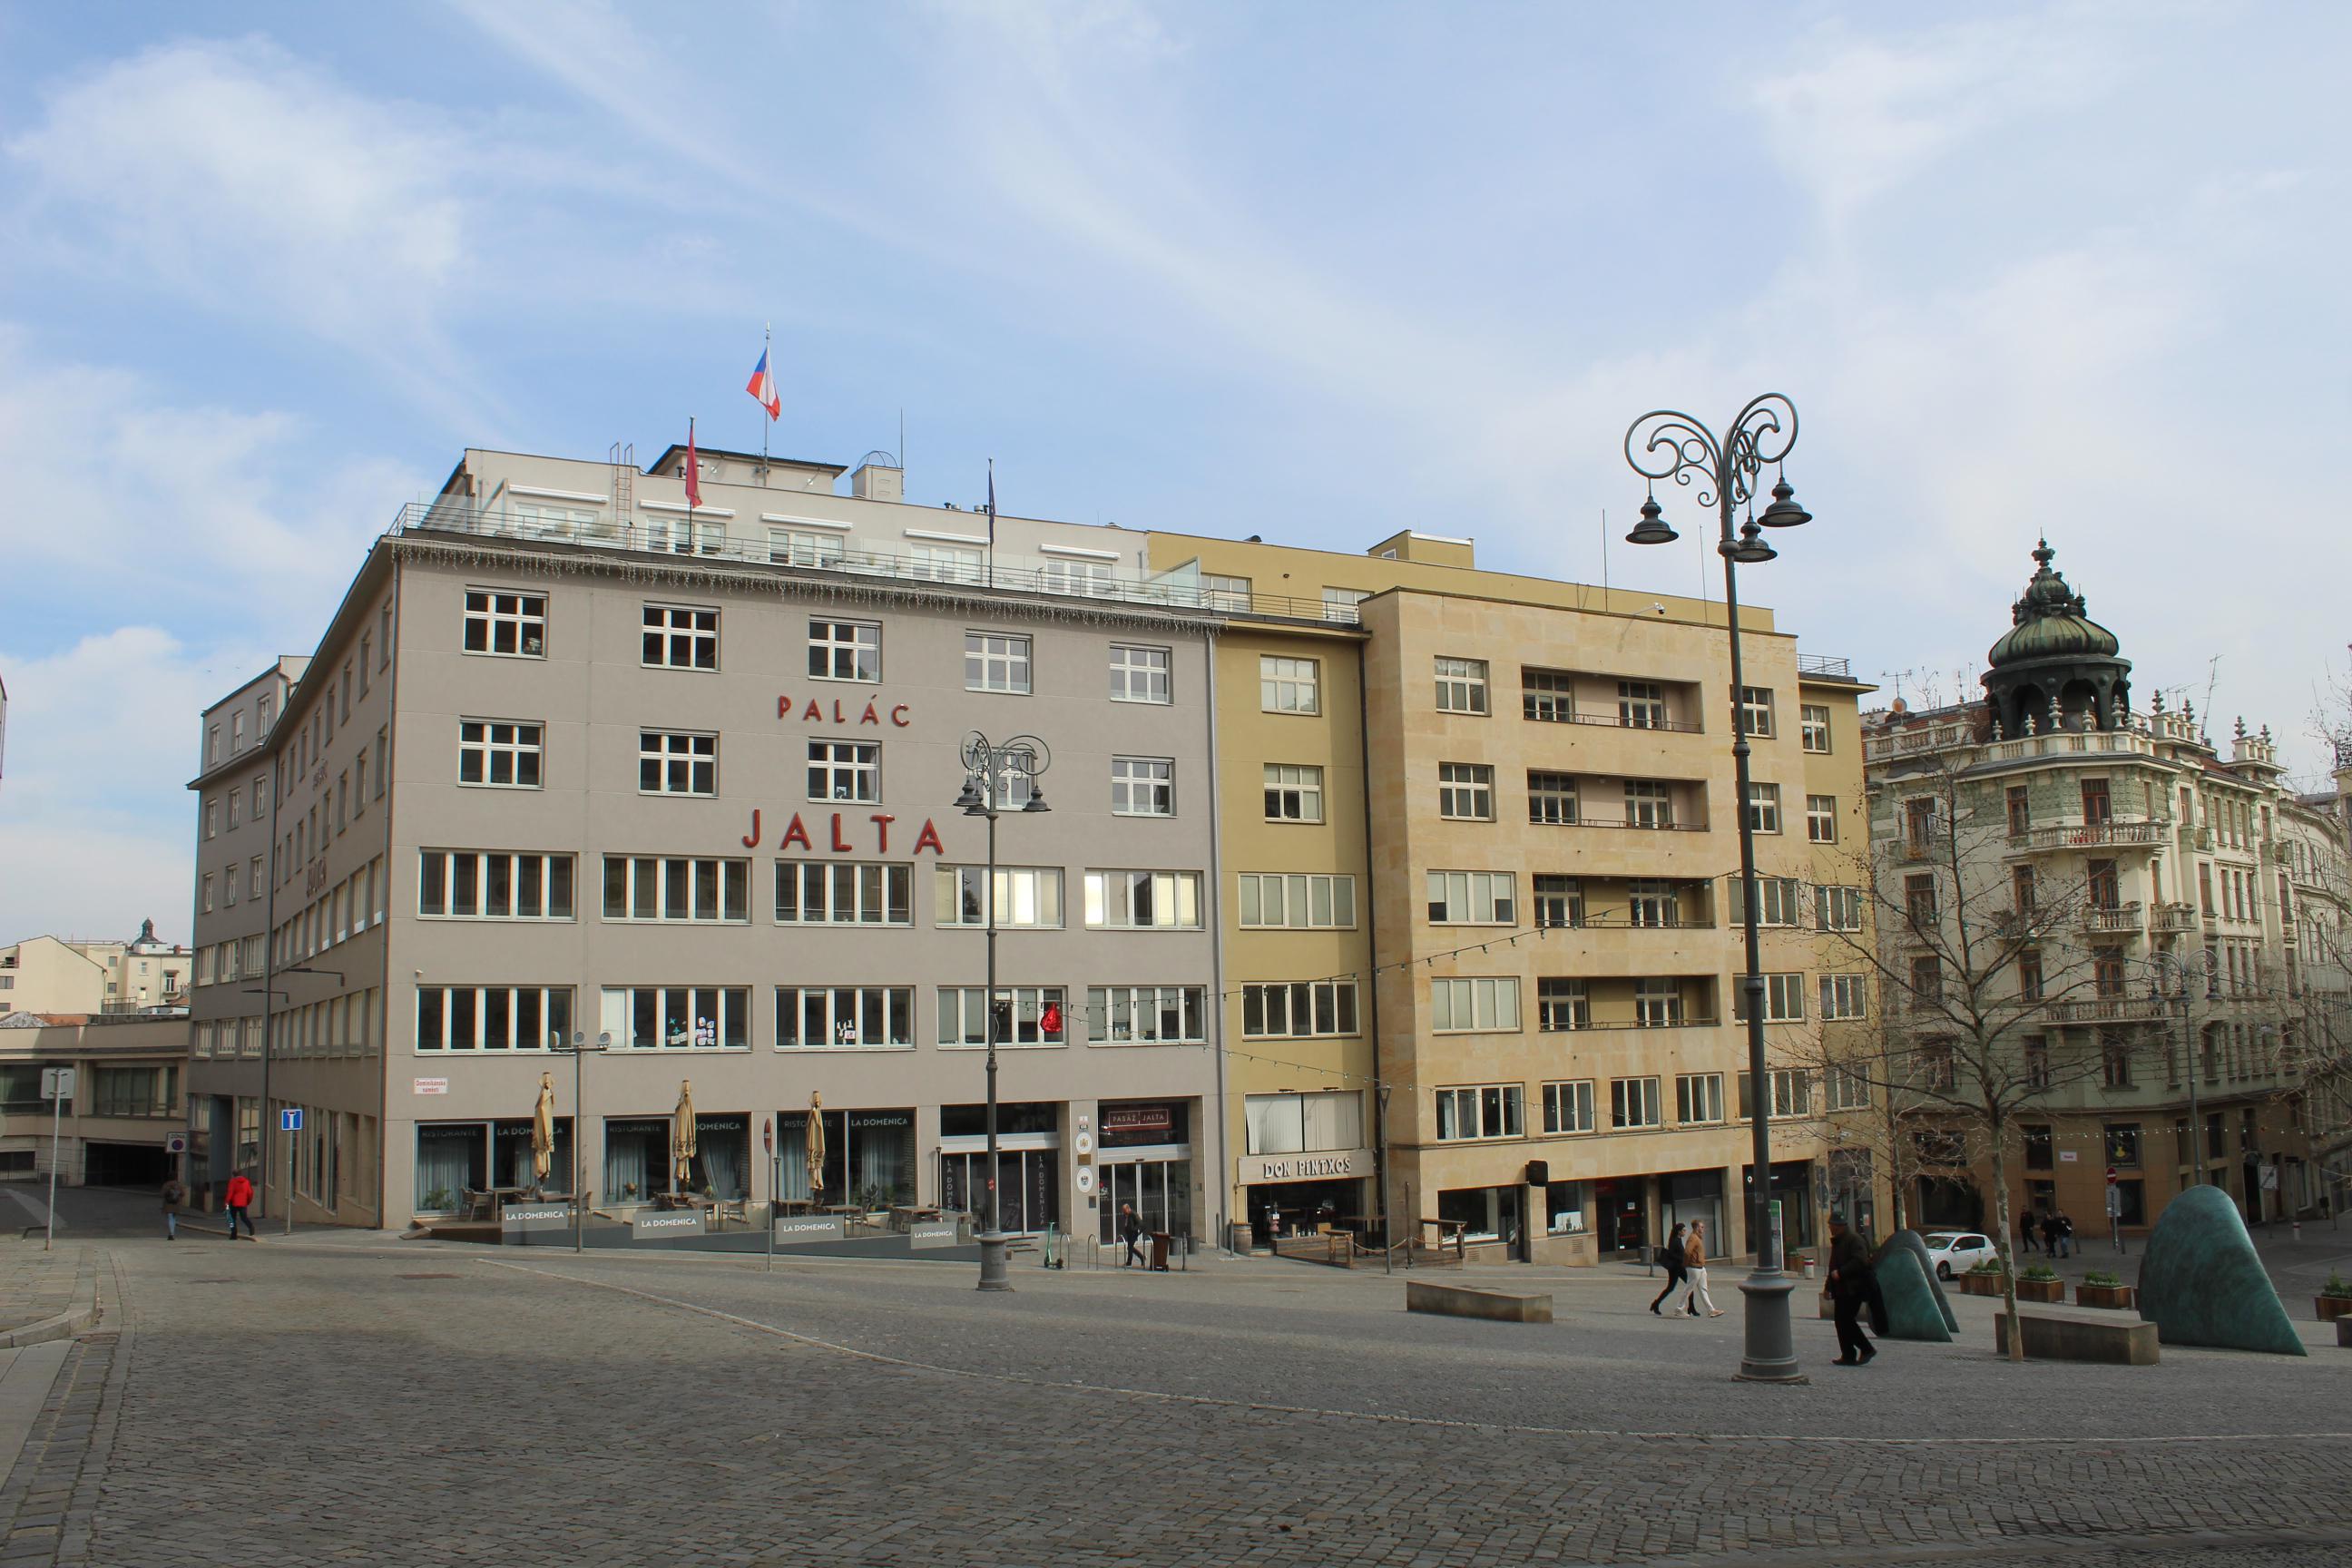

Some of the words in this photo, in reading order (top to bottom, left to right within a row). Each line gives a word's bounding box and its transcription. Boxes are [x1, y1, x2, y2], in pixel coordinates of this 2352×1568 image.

[778, 694, 910, 727] PALÁC
[741, 808, 945, 856] JALTA
[863, 1118, 907, 1126] DOMENICA
[1142, 1113, 1164, 1122] JALTA
[784, 1120, 833, 1128] RISTOTE
[497, 1127, 509, 1136] LA
[1263, 1162, 1290, 1179] DON
[506, 1212, 517, 1220] LA
[518, 1210, 564, 1220] DOMENICA
[652, 1218, 697, 1227] DOMENICA
[795, 1223, 836, 1232] DOMENICA
